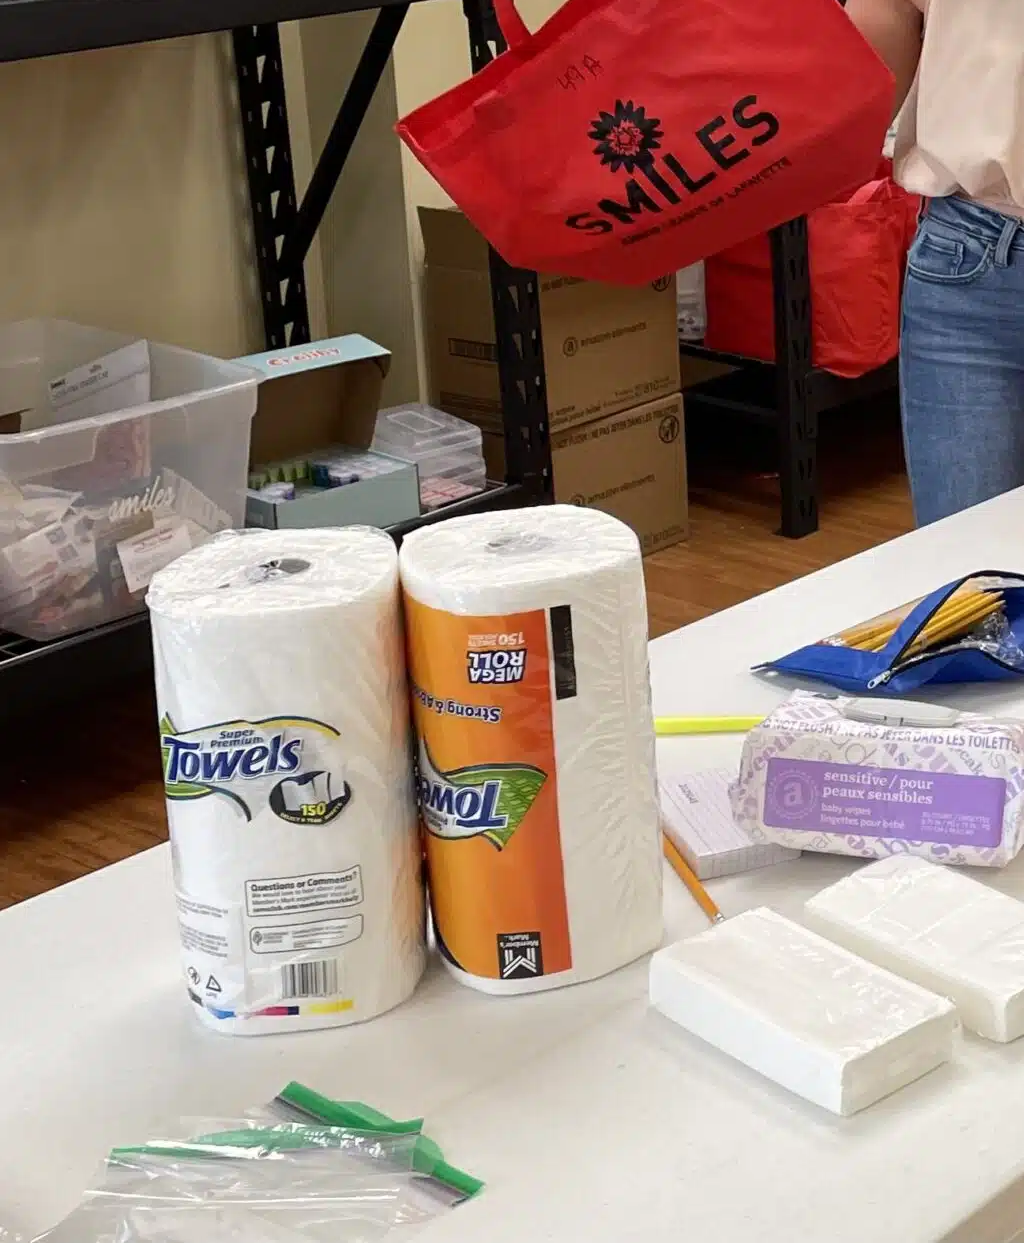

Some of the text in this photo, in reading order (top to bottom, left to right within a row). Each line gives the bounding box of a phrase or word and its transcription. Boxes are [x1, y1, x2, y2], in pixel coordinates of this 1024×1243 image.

[564, 94, 780, 237] SMILES
[109, 475, 176, 524] smiles
[498, 631, 525, 646] 150
[468, 651, 525, 668] ROLL
[469, 666, 523, 682] MEGA
[447, 701, 501, 723] Strong
[210, 737, 265, 748] Premium
[219, 729, 256, 740] Super
[946, 735, 966, 746] LES
[163, 734, 302, 783] Towels
[824, 771, 888, 787] sensitive
[900, 777, 934, 791] pour
[822, 785, 934, 805] peaux sensibles
[300, 802, 328, 817] 150
[250, 882, 295, 892] Questions
[296, 880, 305, 888] or
